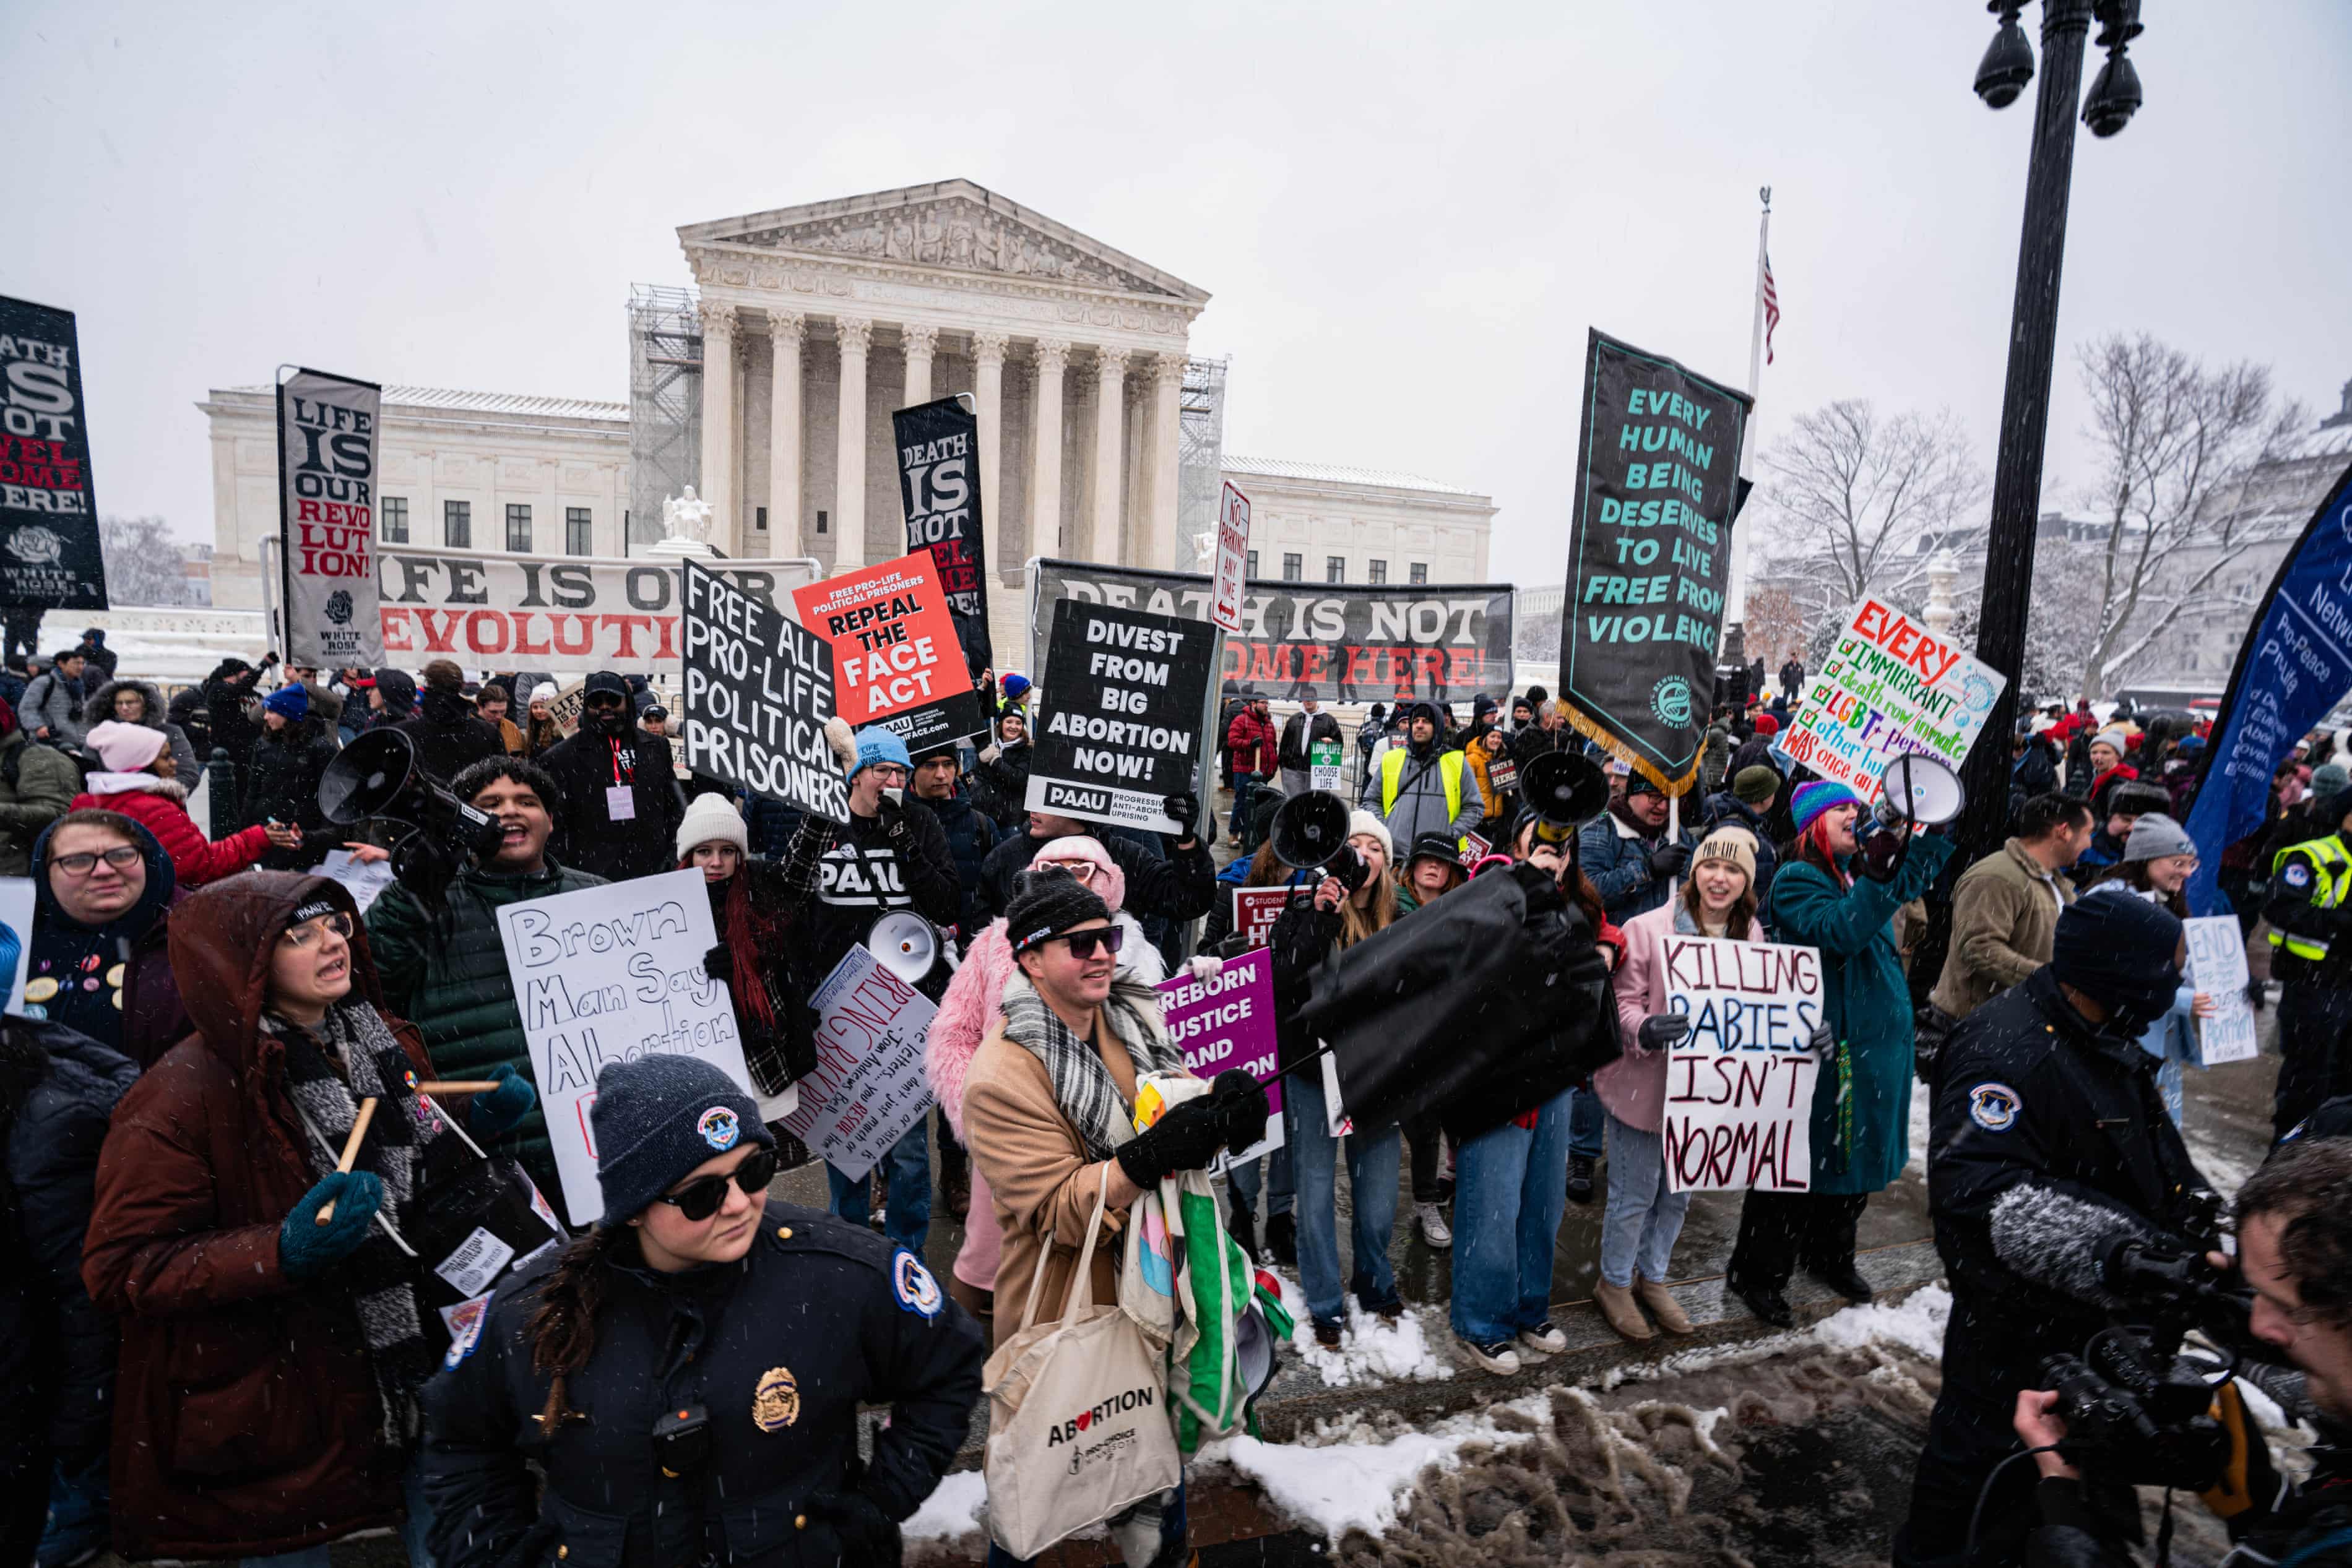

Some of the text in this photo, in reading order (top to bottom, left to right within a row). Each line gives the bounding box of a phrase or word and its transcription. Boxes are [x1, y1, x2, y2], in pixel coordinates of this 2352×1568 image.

[0, 361, 74, 415] S
[293, 397, 371, 434] LIFE
[1628, 389, 1711, 431] EVERY
[297, 424, 371, 479] IS
[902, 433, 969, 468] DEATH
[1620, 424, 1713, 470] HUMAN
[296, 473, 370, 506] OUR
[906, 457, 969, 520] IS
[1625, 463, 1702, 499] BEING
[298, 499, 370, 529] REVO
[908, 509, 969, 548] NOT
[1229, 499, 1240, 526] NO
[1600, 498, 1718, 546] DESERVES
[298, 524, 370, 554] LUT
[911, 540, 974, 569] EL
[1221, 522, 1245, 559] PARKING
[1615, 537, 1711, 578] TO LIVE
[3, 567, 76, 580] WHITE
[300, 549, 370, 578] ION!
[1224, 556, 1237, 578] ANY
[517, 563, 596, 609] IS
[813, 575, 924, 614] POLITICAL PRISONERS
[829, 572, 902, 601] FREE PRO-LIFE
[1222, 577, 1236, 600] TIME
[1585, 575, 1724, 616] FREE FROM
[380, 606, 683, 658] EVOLUTI
[688, 566, 831, 682] FREE ALL
[827, 593, 923, 637] REPEAL
[1286, 598, 1349, 640] IS
[1361, 600, 1489, 644] NOT
[320, 632, 360, 640] WHITE
[857, 621, 909, 653] THE
[1086, 619, 1183, 655] DIVEST
[1588, 616, 1716, 655] VIOLENCE
[1853, 600, 1961, 687] EVERY
[687, 615, 831, 723] PRO-LIFE
[842, 636, 938, 687] FACE
[1090, 652, 1169, 686] FROM
[1344, 645, 1486, 686] HERE!
[1848, 640, 1960, 721] IMMIGRANT
[868, 669, 933, 713] ACT
[1101, 687, 1148, 714] BIG
[687, 668, 844, 776] POLITICAL
[1047, 712, 1191, 754] ABORTION
[1839, 670, 1967, 760] death row inmate
[1312, 743, 1342, 755] LOVE LIFE
[1782, 724, 1819, 762] WAS
[1817, 749, 1851, 779] once
[1854, 773, 1872, 792] an
[1817, 721, 1861, 758] other
[687, 720, 850, 824] PRISONERS
[1073, 747, 1154, 781] NOW!
[1315, 767, 1337, 777] CHOOSE
[1320, 778, 1332, 788] LIFE
[1050, 786, 1107, 811] PAAU
[1112, 810, 1149, 821] UPRISING
[1703, 841, 1738, 858] PRO-LIFE
[510, 902, 687, 968] Brown
[1664, 939, 1818, 995] KILLING
[527, 952, 718, 1031] Man Say
[828, 963, 915, 1051] BRING
[1670, 994, 1817, 1052] BABIES
[1184, 1038, 1233, 1069] AND
[1669, 1054, 1814, 1108] ISN'T
[825, 1093, 849, 1114] Bell
[836, 1100, 868, 1137] RESCUE
[1666, 1116, 1807, 1190] NORMAL
